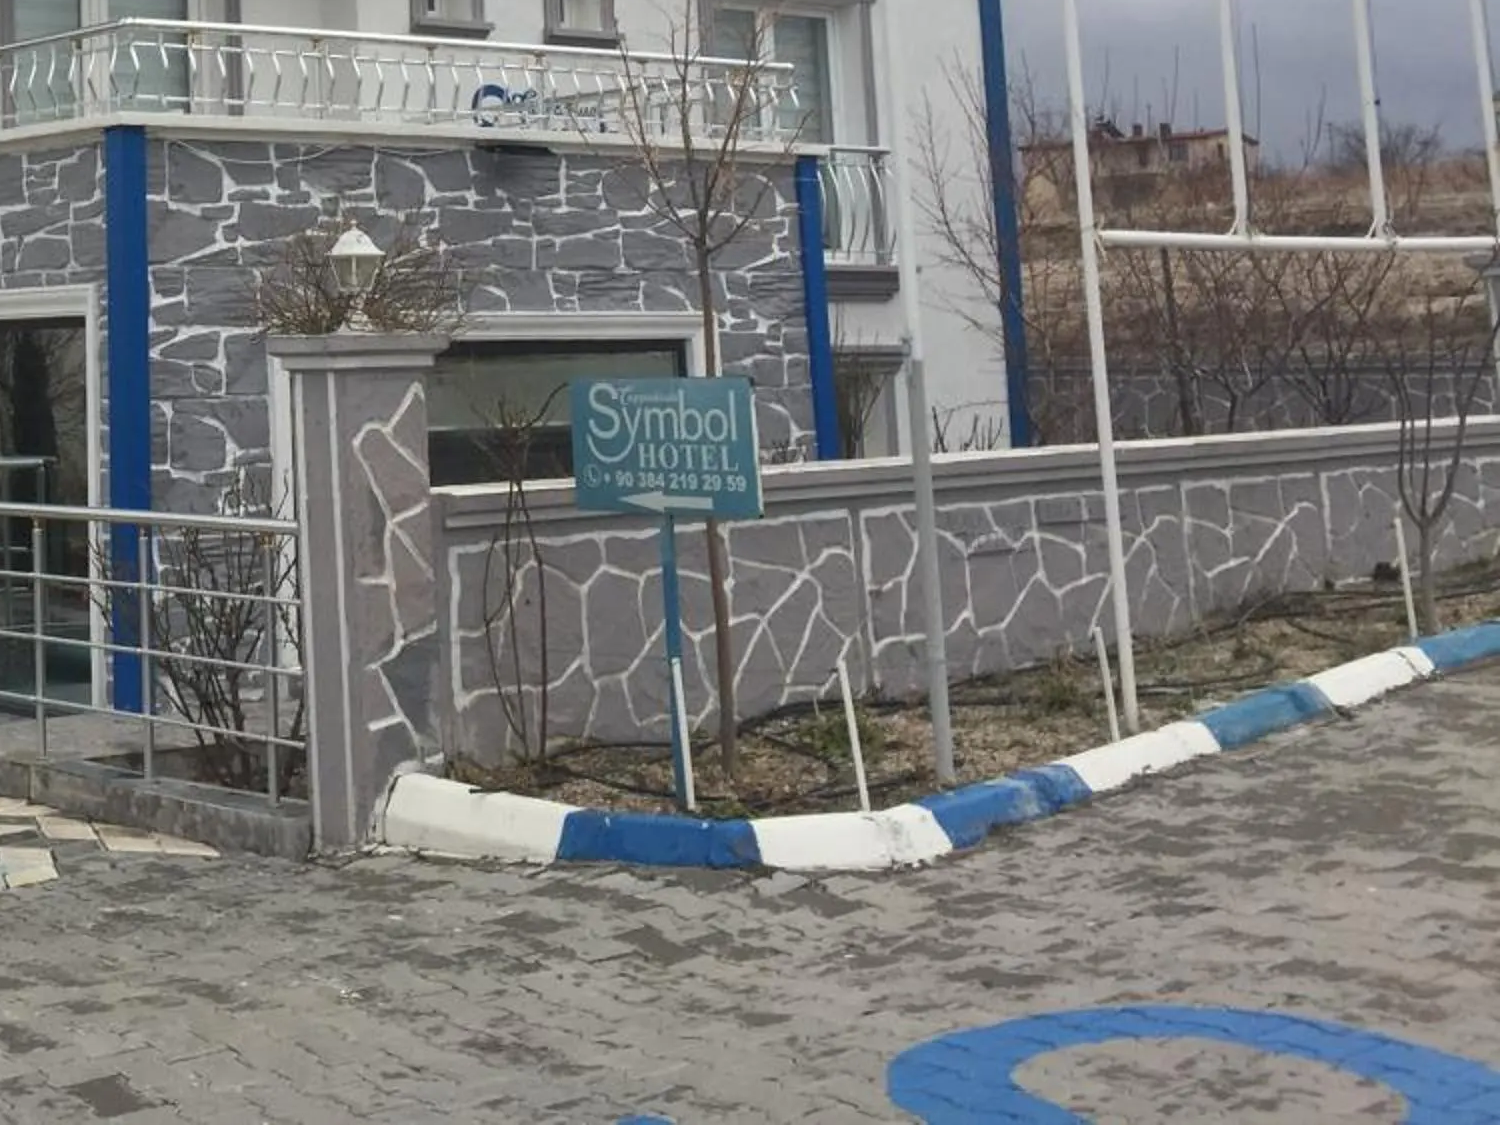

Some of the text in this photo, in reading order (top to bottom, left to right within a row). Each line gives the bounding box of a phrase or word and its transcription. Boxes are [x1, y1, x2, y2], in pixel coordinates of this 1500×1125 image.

[586, 382, 737, 463] Symbol
[638, 442, 738, 471] HOTEL
[669, 473, 698, 490] 219
[726, 475, 747, 492] 59
